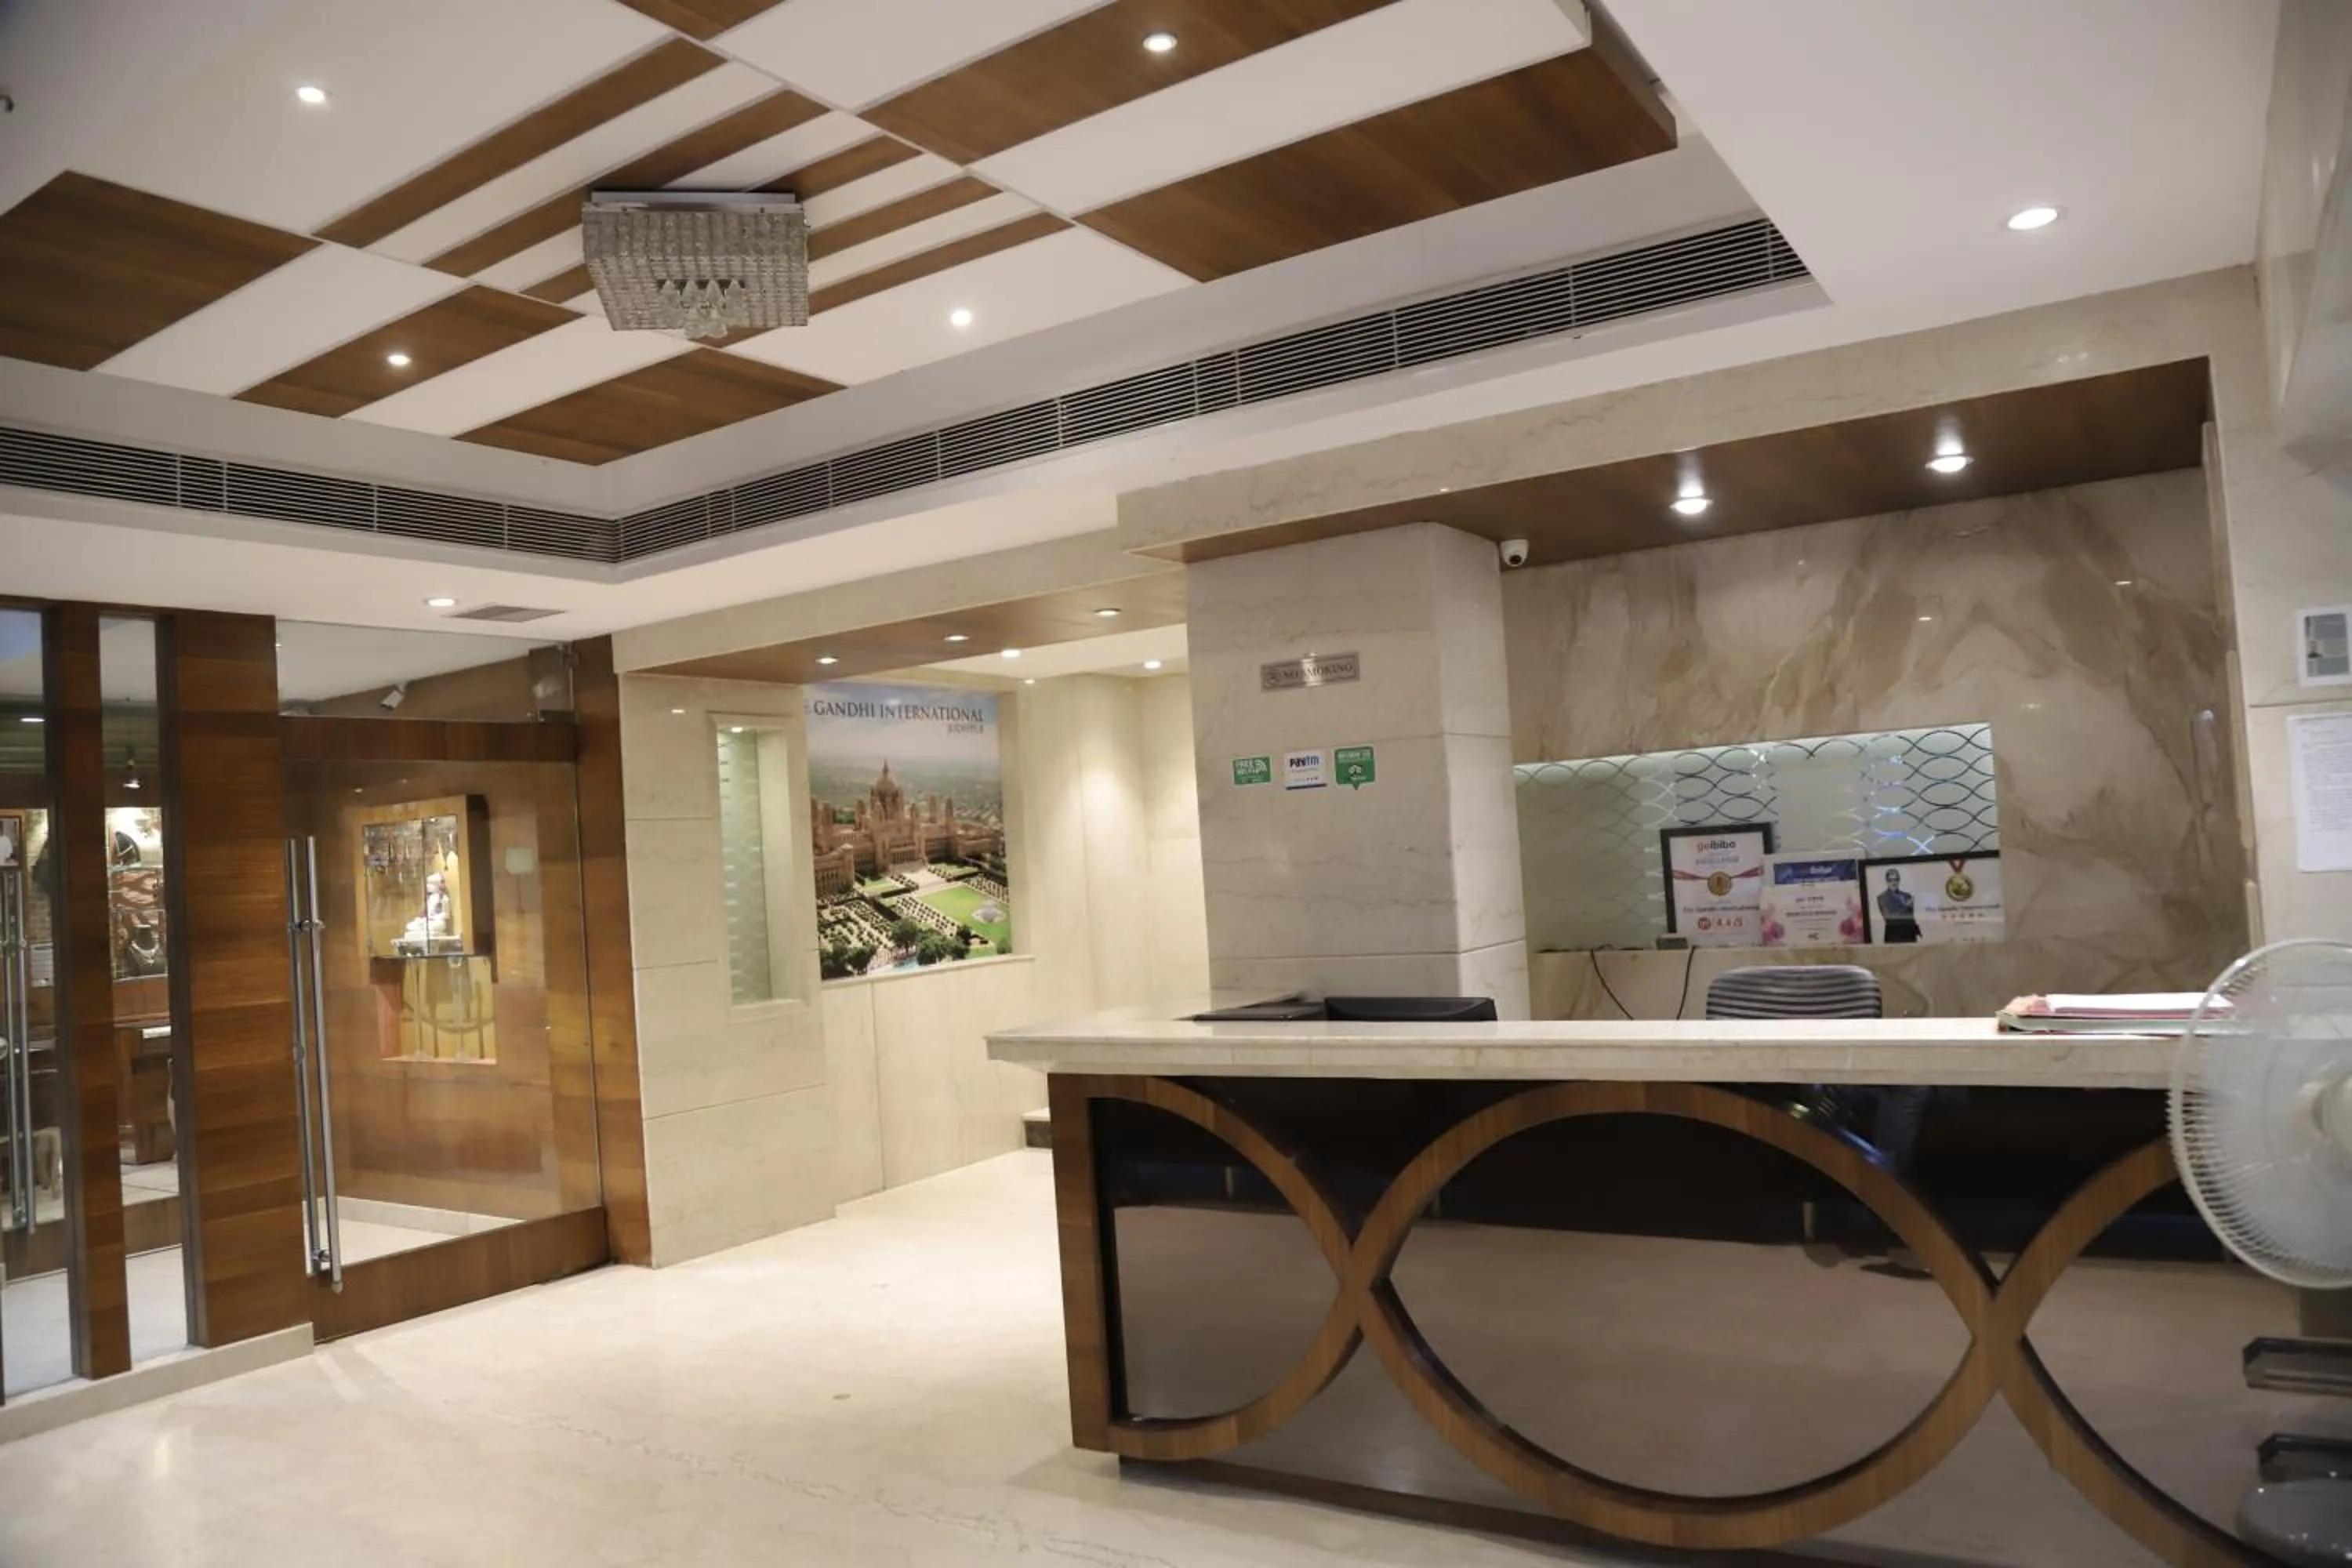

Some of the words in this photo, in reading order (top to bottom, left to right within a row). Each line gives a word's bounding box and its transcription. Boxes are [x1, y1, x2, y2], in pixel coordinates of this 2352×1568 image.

[814, 701, 875, 718] GANDHI
[880, 704, 983, 722] INTERNATIONAL
[1697, 840, 1737, 852] goibibo
